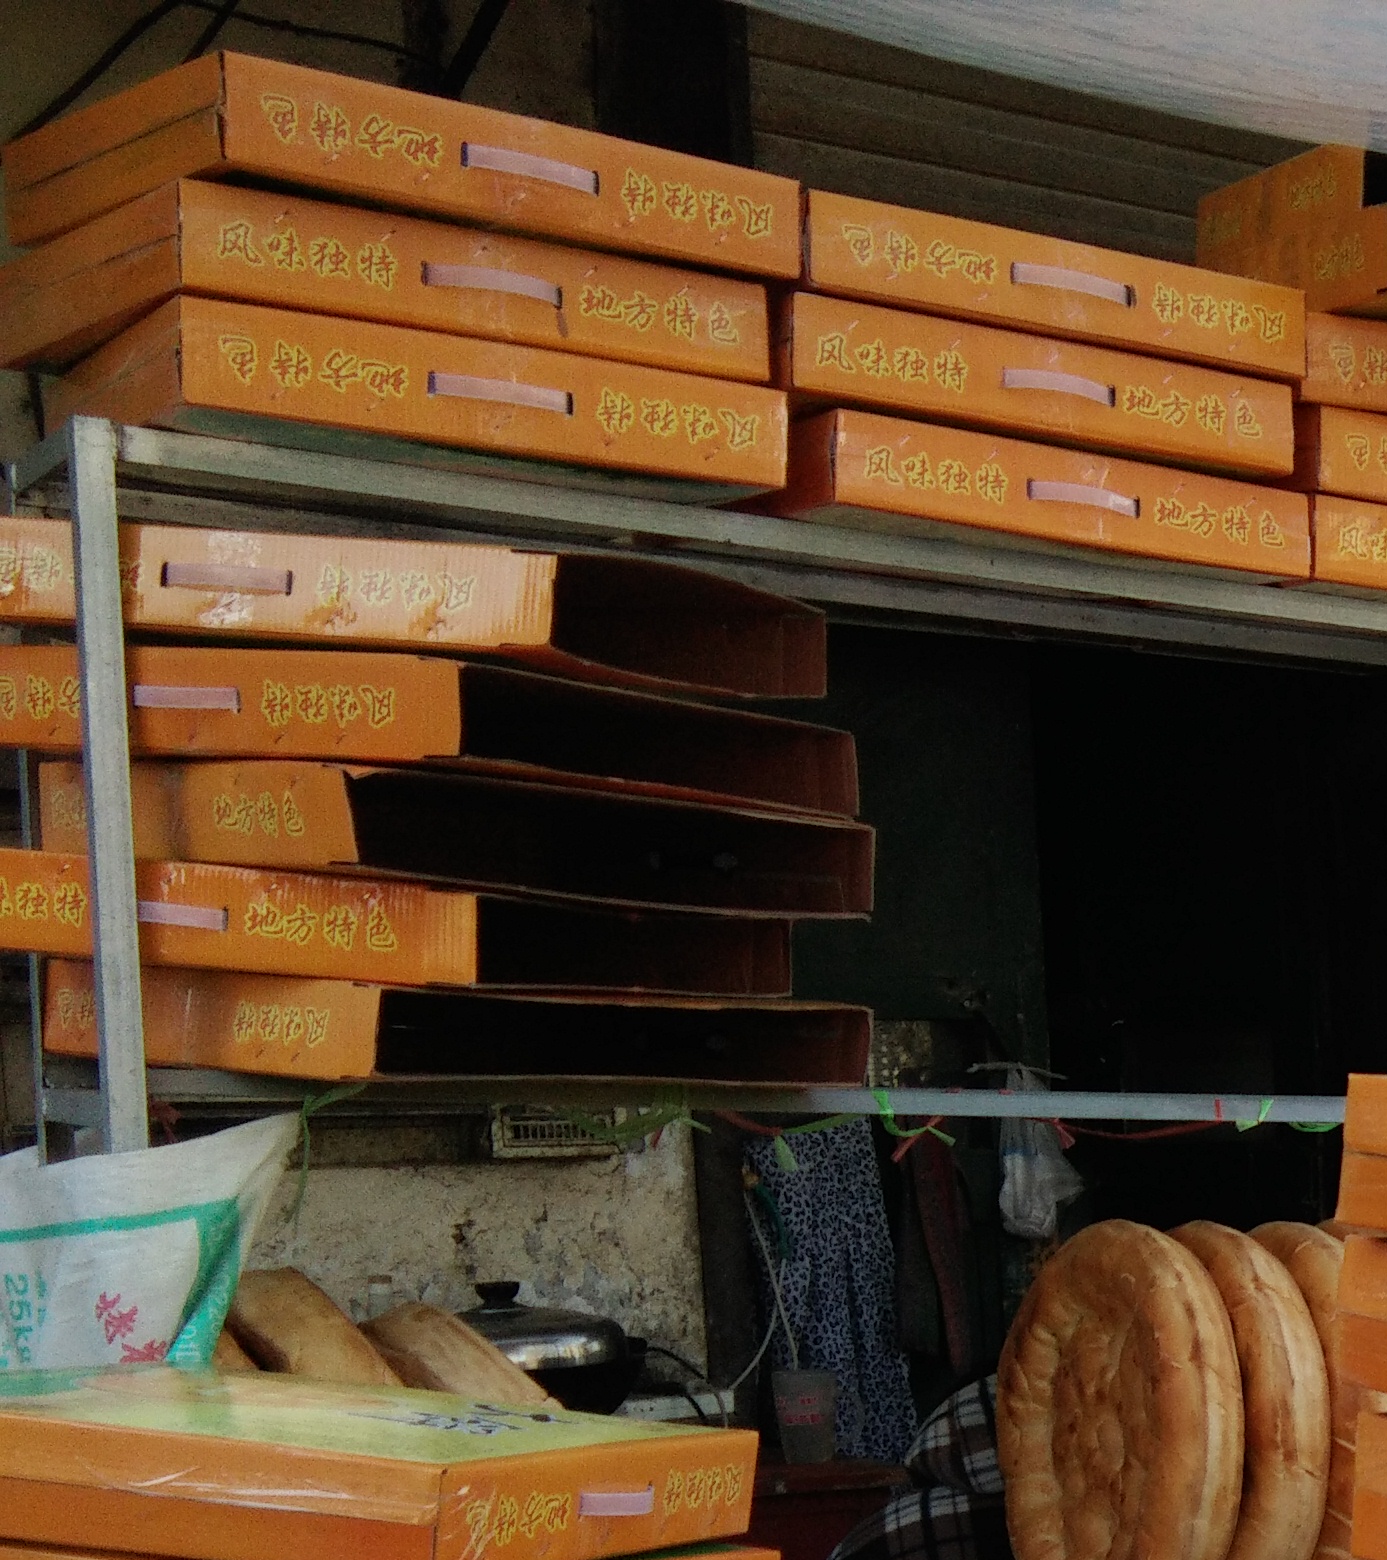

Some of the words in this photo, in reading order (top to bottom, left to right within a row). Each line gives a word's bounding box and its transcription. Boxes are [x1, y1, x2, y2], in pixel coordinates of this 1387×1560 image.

[262, 95, 441, 167] 地方特色
[622, 169, 774, 236] 风味独特
[219, 222, 396, 289] 风味独特
[843, 225, 996, 284] 地方特色
[579, 287, 741, 344] 地方特色
[1154, 285, 1285, 343] 风味独特
[221, 335, 408, 397] 地方特色
[816, 334, 968, 392] 风味独特
[599, 389, 759, 448] 风味独特
[1125, 385, 1262, 437] 地方特色
[865, 446, 1007, 503] 风味独特
[1155, 499, 1285, 548] 地方特色
[245, 902, 398, 953] 地方特色
